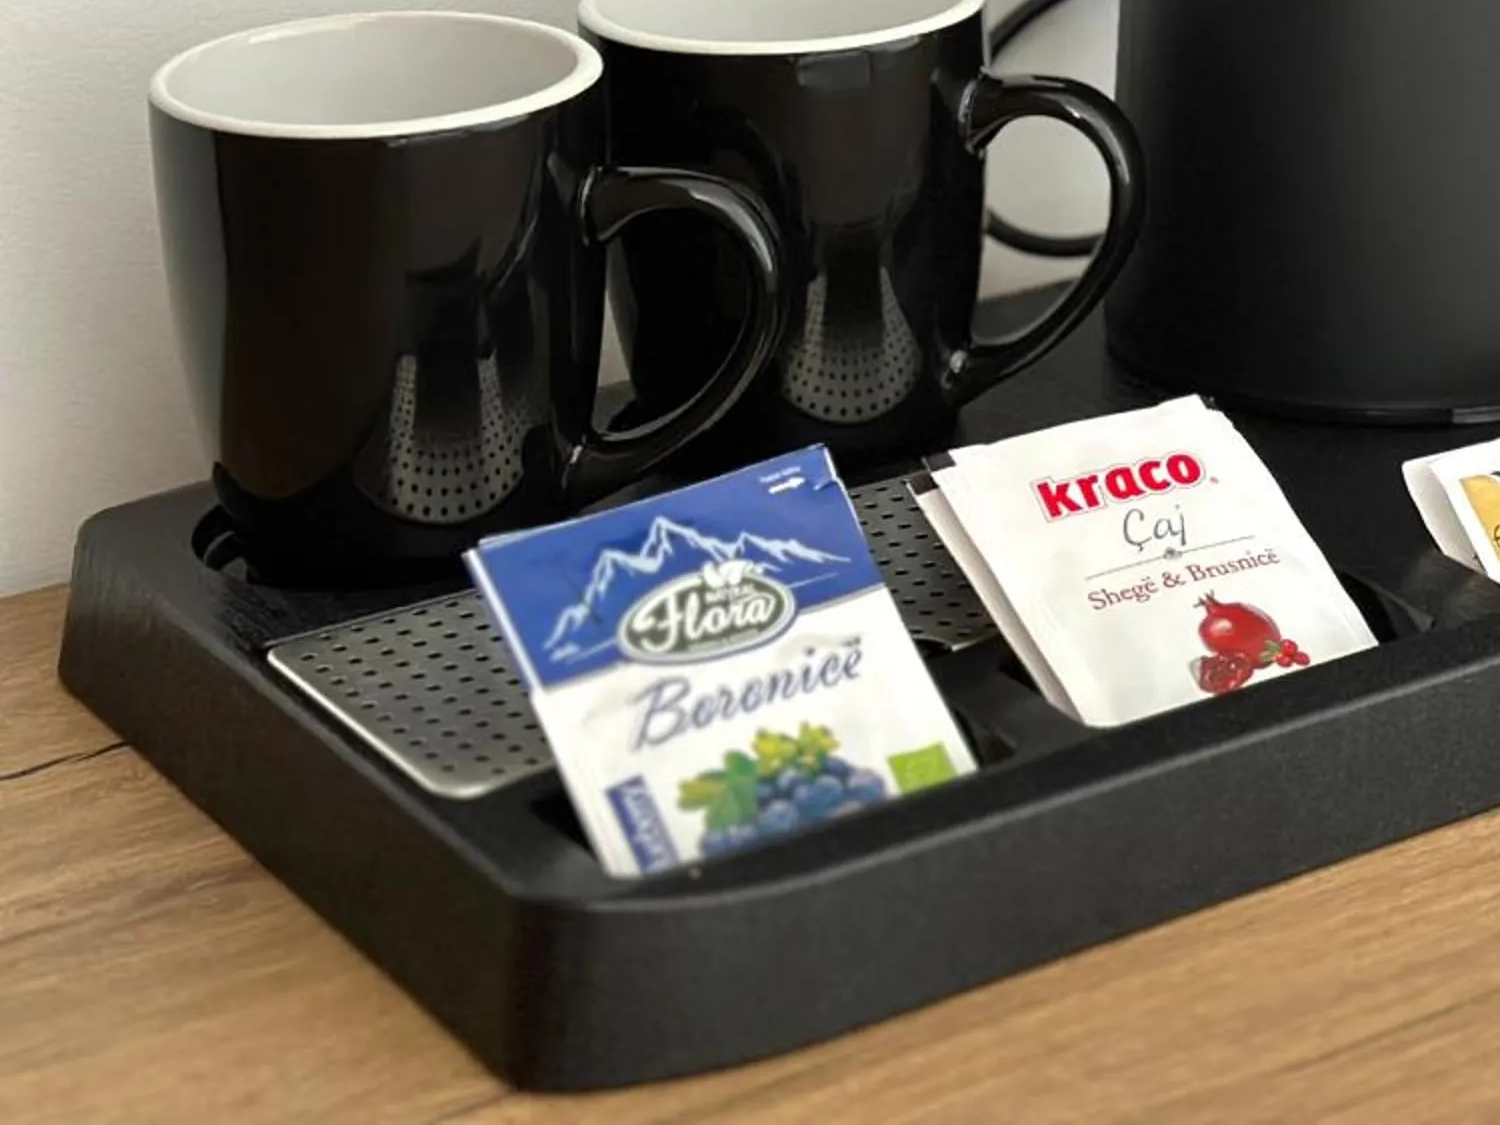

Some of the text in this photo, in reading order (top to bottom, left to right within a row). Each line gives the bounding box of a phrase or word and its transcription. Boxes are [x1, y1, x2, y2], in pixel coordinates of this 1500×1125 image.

[1035, 453, 1202, 520] kraco
[1122, 504, 1188, 552] Çaj
[1087, 548, 1281, 611] Shegë & Brusnicë
[632, 591, 777, 654] Flora
